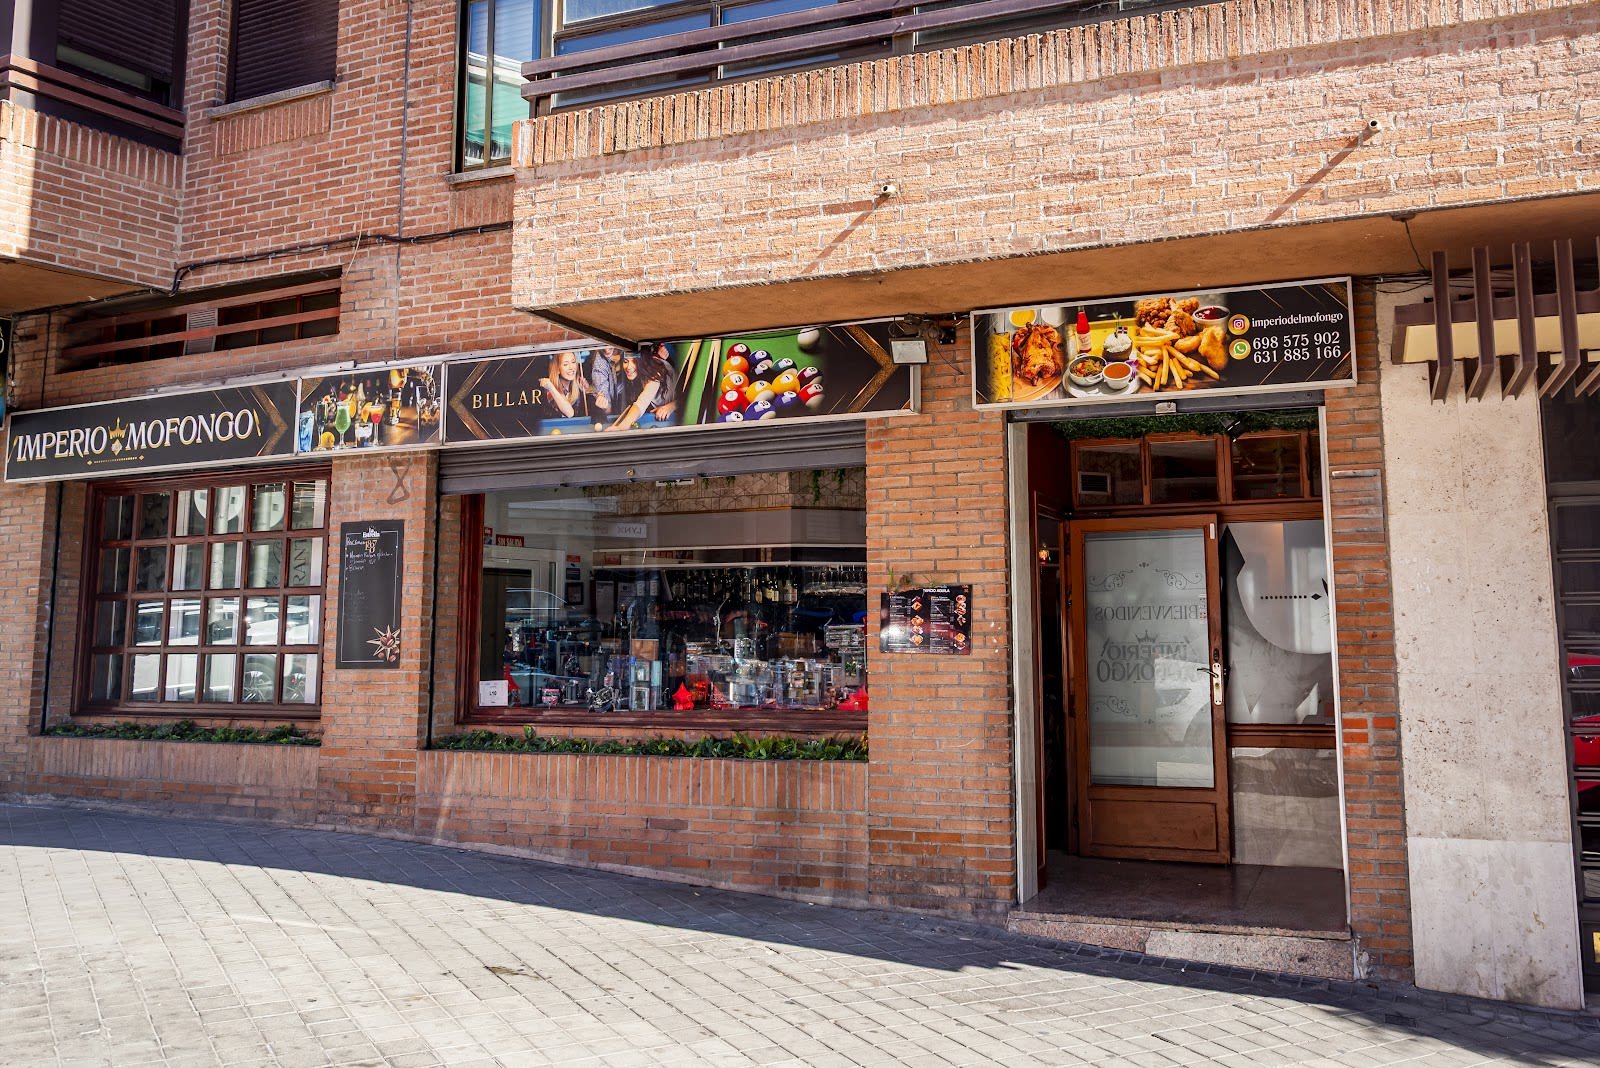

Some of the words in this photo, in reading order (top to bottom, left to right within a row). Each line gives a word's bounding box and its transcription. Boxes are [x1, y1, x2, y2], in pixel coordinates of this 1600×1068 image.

[1252, 312, 1343, 328] imperiodelmofongo
[1252, 336, 1279, 350] 698
[1283, 333, 1309, 348] 575
[1313, 331, 1340, 346] 902
[1253, 350, 1278, 364] 631
[1283, 348, 1310, 362] 885
[1315, 345, 1341, 359] 166
[472, 389, 542, 409] BILLAR
[16, 426, 108, 462] IMPERIO
[125, 408, 253, 451] MOFONGO
